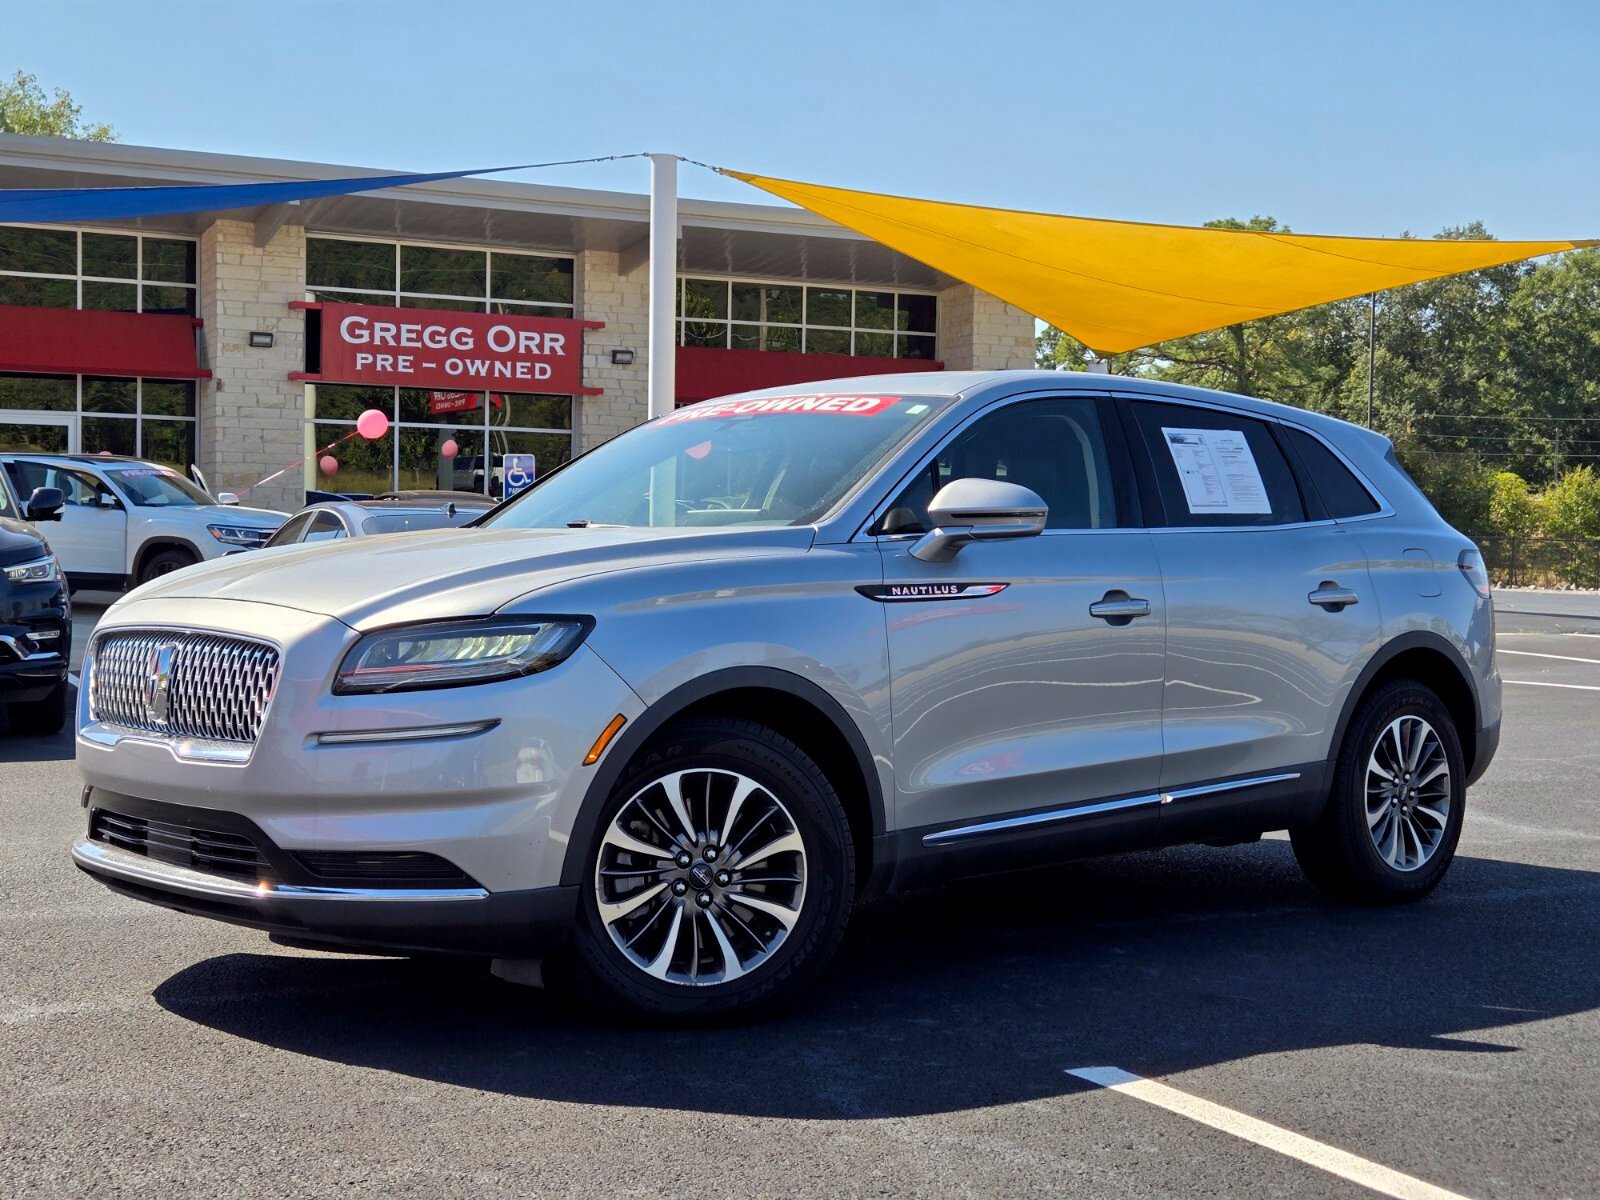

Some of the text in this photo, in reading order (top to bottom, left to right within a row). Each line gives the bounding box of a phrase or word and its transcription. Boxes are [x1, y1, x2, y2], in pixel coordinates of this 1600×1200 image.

[340, 315, 566, 356] GREGG ORR
[355, 352, 414, 374] PRE
[444, 357, 551, 380] OWNED
[656, 394, 881, 426] PRE-OWNED
[891, 585, 958, 596] NAUTILUS
